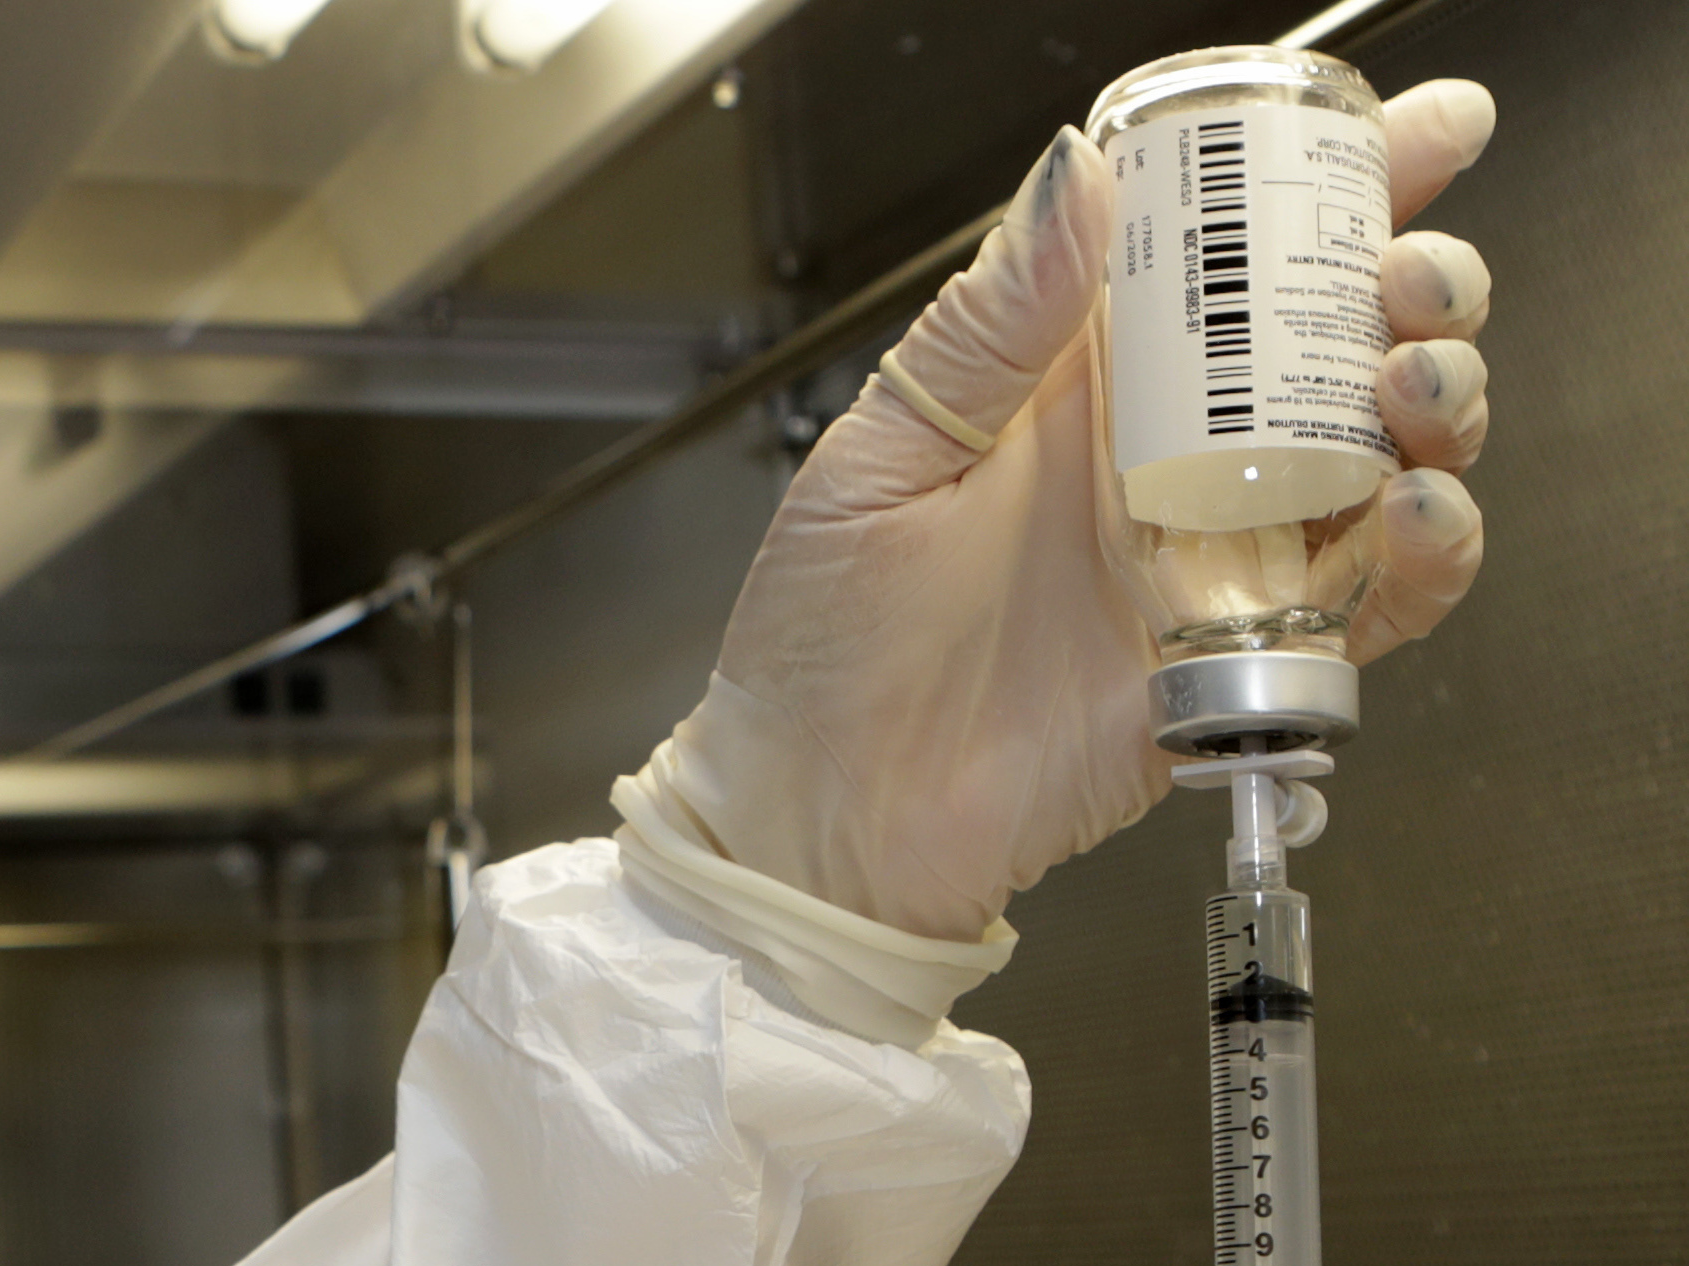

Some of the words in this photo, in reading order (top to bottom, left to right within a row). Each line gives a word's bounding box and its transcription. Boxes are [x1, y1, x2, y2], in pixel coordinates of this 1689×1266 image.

[1316, 137, 1341, 150] CORP.
[1135, 148, 1146, 171] Lot:
[1126, 222, 1137, 277] 06/2020
[1183, 229, 1198, 252] NDC
[1286, 255, 1314, 265] ENTRY.
[1184, 255, 1201, 335] 0143-9983-91
[1275, 287, 1305, 296] Sodium
[1274, 309, 1306, 319] infusion
[1284, 319, 1308, 328] sterile
[1294, 330, 1307, 338] the
[1301, 352, 1321, 360] more
[1266, 396, 1292, 405] grams
[1305, 398, 1313, 406] to
[1267, 419, 1308, 429] DILUTION
[1310, 421, 1345, 432] FURTHER
[1292, 430, 1318, 440] MANY
[1243, 922, 1255, 946] 1
[1244, 960, 1263, 986] 2
[1248, 1038, 1267, 1062] 4
[1250, 1076, 1268, 1101] 5
[1251, 1115, 1270, 1140] 6
[1252, 1155, 1271, 1178] 7
[1254, 1193, 1272, 1218] 8
[1255, 1232, 1274, 1257] 9
